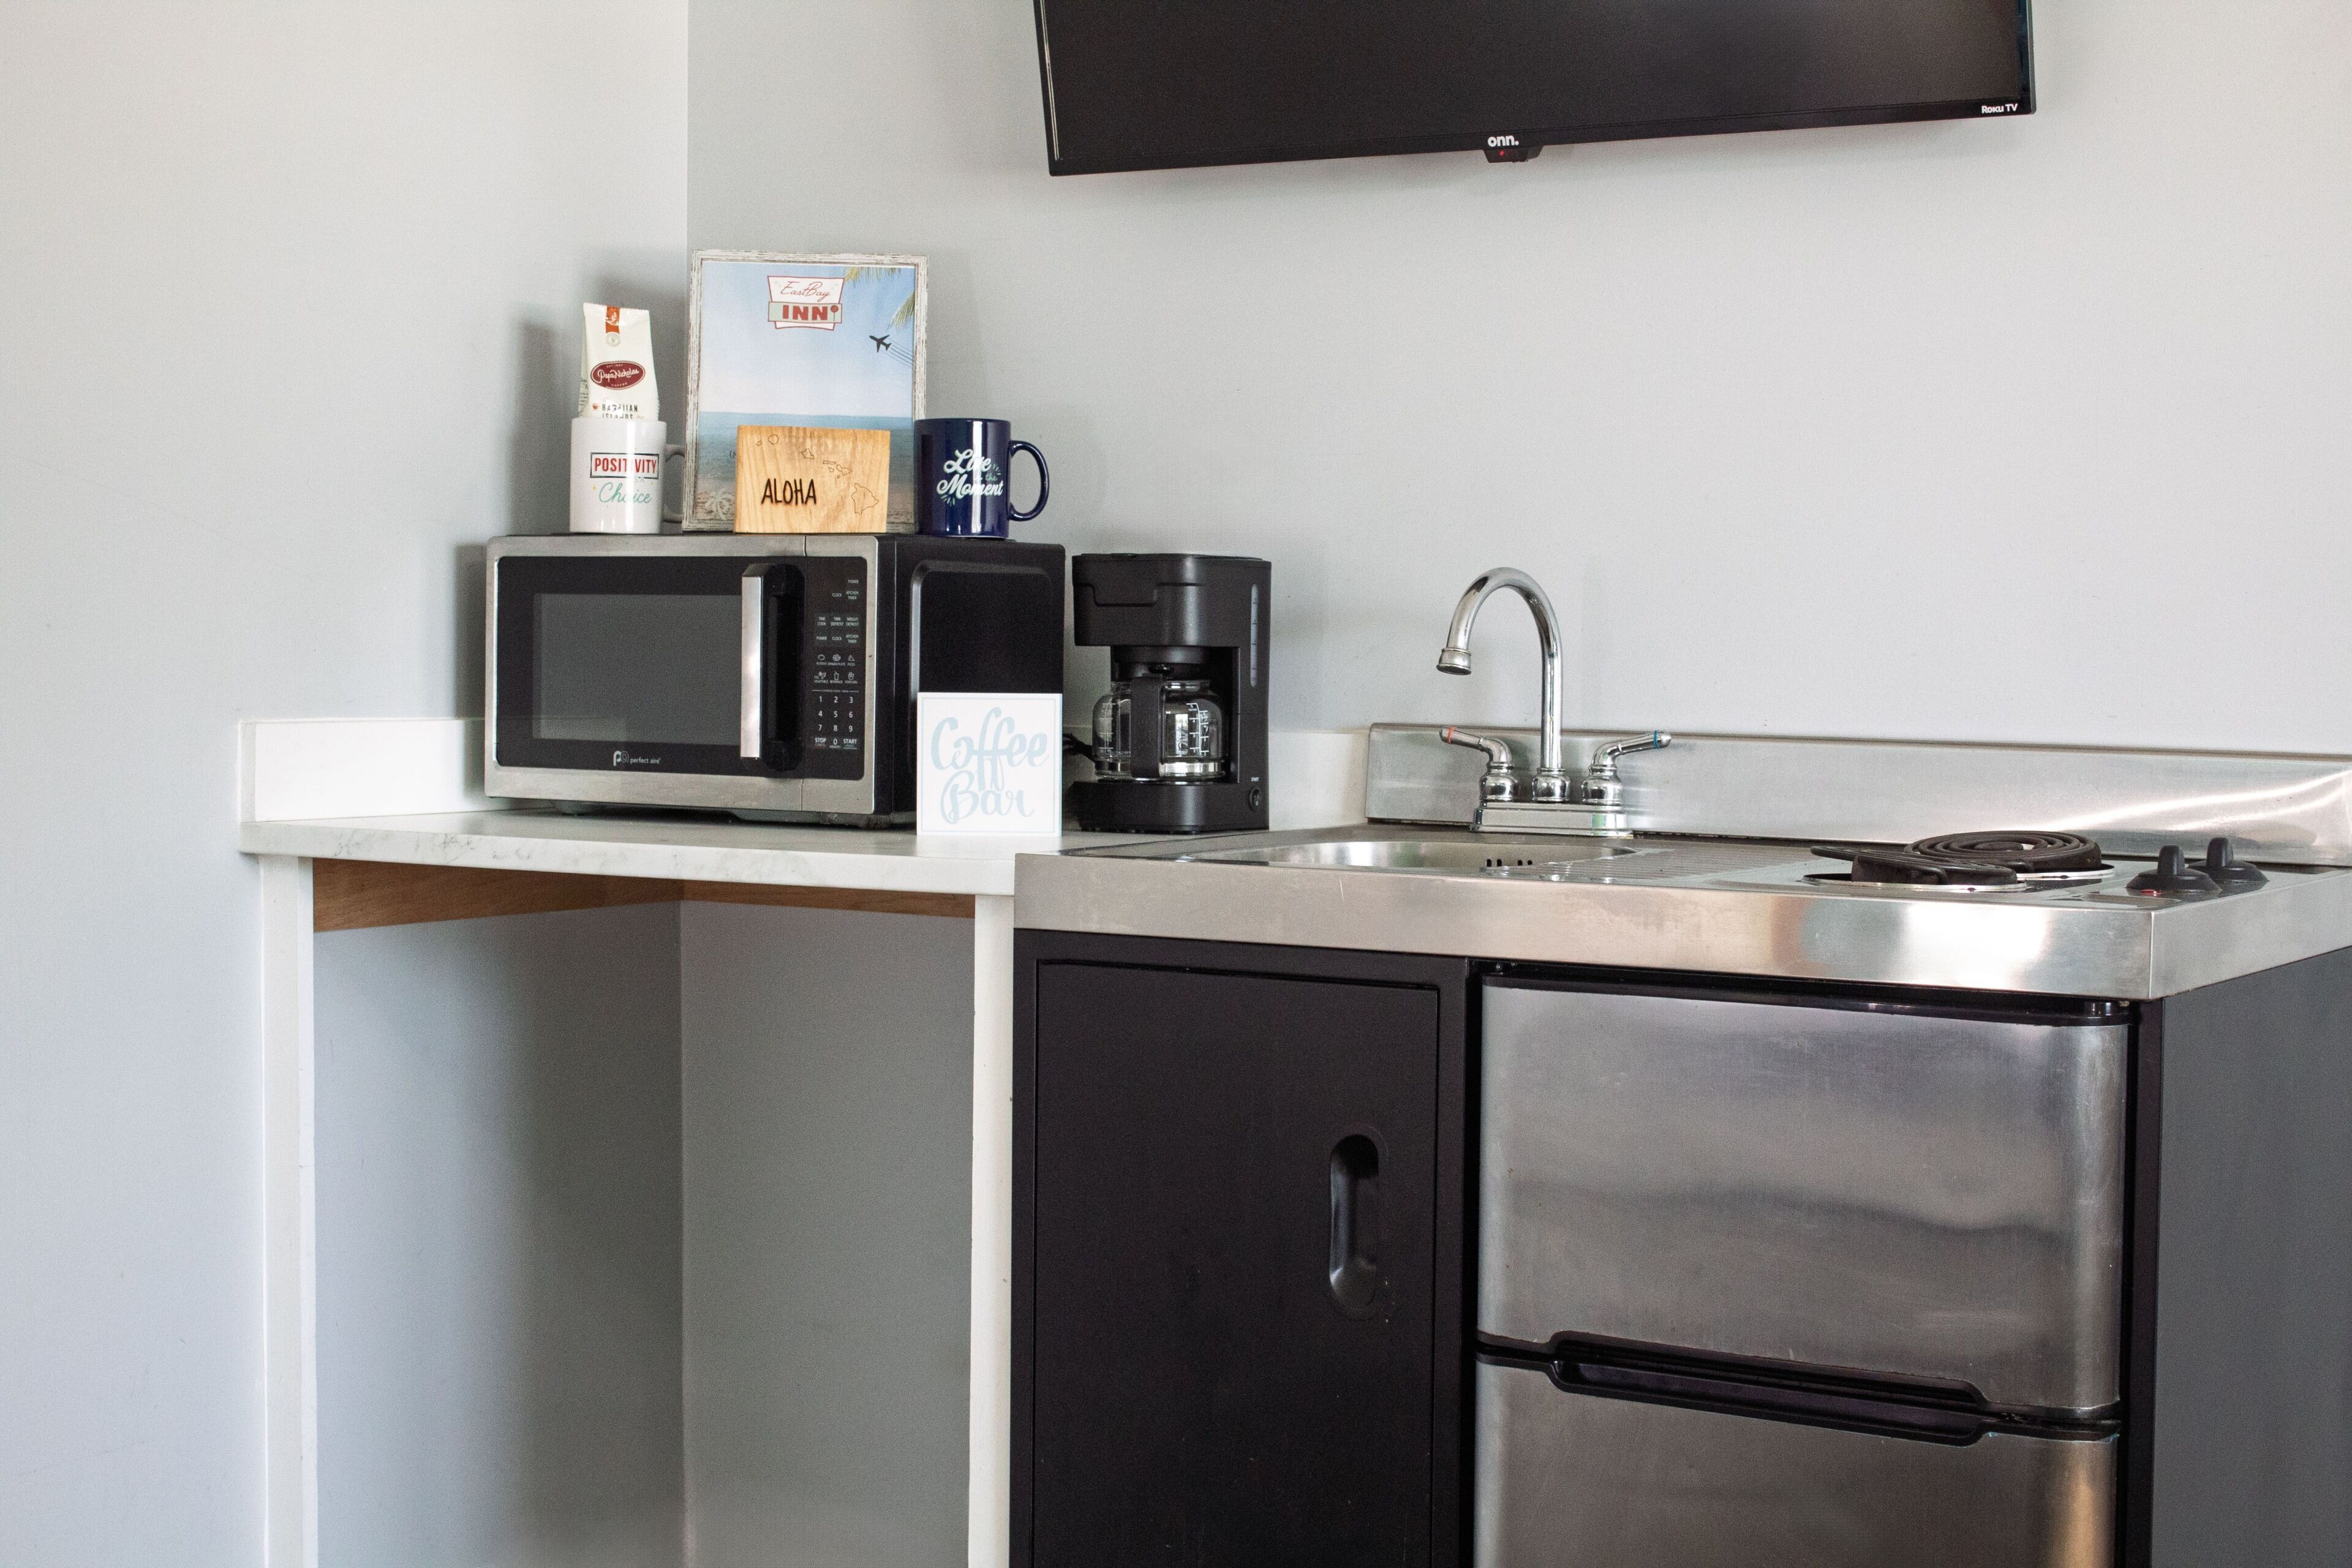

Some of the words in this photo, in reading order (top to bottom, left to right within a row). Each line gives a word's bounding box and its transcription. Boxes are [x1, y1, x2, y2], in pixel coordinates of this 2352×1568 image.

[1981, 105, 2004, 114] Roku
[2005, 103, 2018, 112] TV
[1487, 135, 1519, 147] onn.
[782, 304, 828, 320] INN
[595, 458, 657, 473] POSITVITY
[943, 449, 992, 474] Lie
[599, 482, 652, 504] Chice
[761, 478, 816, 505] ALOHA
[931, 707, 1049, 792] Coffee
[940, 770, 1035, 824] Bar
